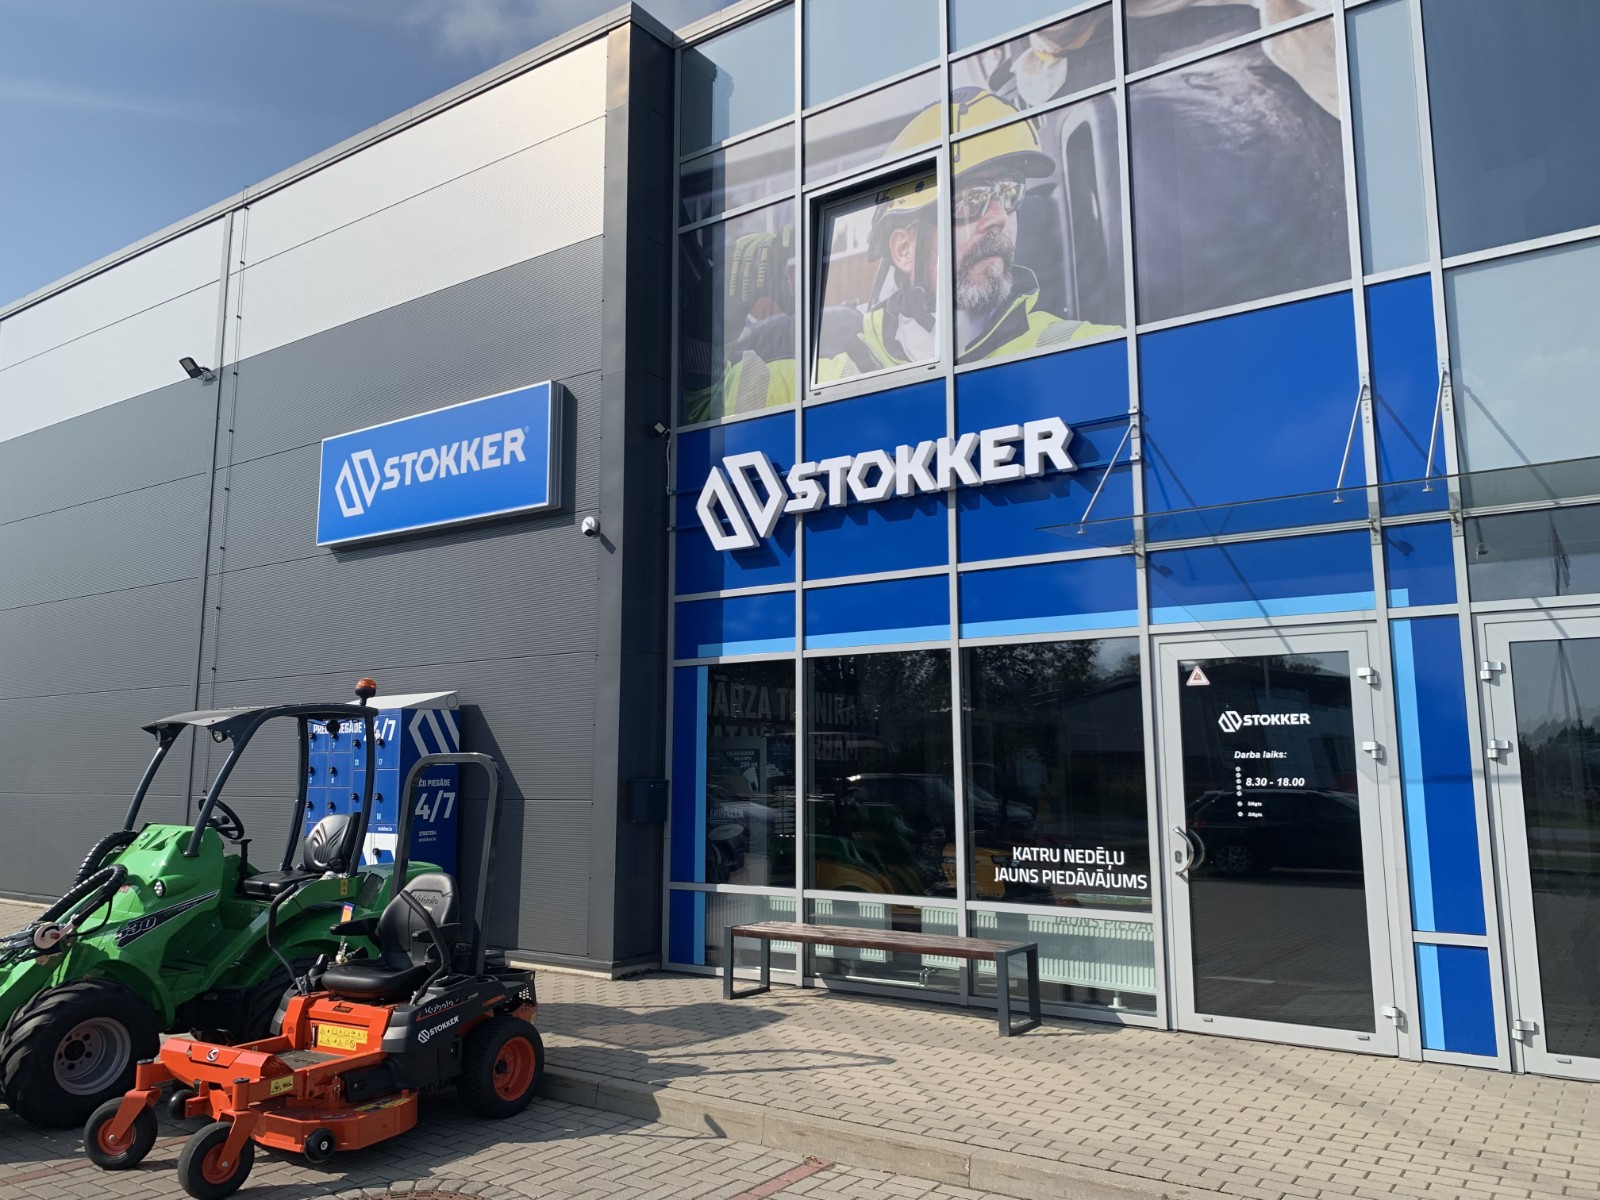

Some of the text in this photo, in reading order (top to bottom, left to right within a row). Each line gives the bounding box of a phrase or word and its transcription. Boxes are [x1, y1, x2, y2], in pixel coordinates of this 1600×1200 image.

[381, 427, 526, 491] STOKKER
[784, 416, 1078, 513] STOKKER
[776, 687, 857, 725] TNIKA
[338, 719, 363, 734] IEGĀDE
[1243, 713, 1312, 726] STOKKER
[1234, 750, 1287, 759] Darba laiks:
[427, 778, 451, 787] PIEGĀDE
[1245, 778, 1268, 787] 8.30
[1277, 777, 1305, 787] 18.00
[414, 789, 456, 823] 4/7
[1012, 846, 1125, 870] KATRU NEDĒĻU
[994, 867, 1148, 889] JAUNS PIEDĀVĀJUMS
[424, 1000, 454, 1014] Kubota
[429, 1015, 460, 1036] STOKKER
